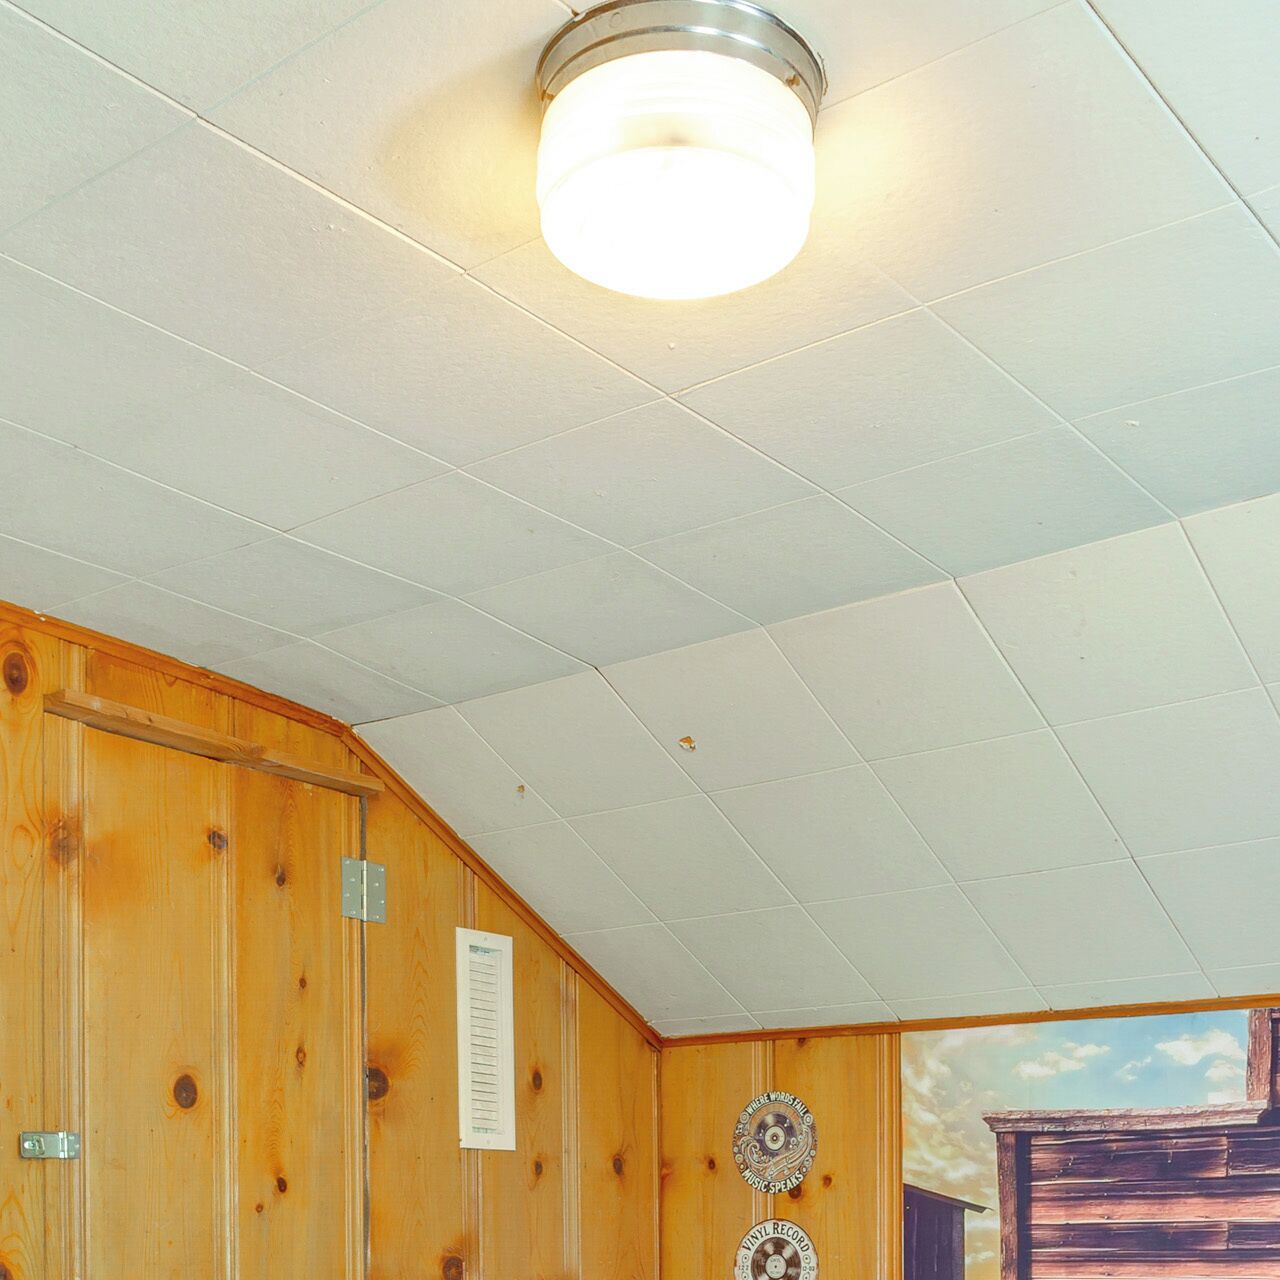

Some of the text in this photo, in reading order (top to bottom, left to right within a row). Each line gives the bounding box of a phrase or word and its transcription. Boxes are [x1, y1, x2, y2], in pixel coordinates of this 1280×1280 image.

[745, 1091, 808, 1117] WHERE WORDS FAIL
[741, 1168, 805, 1194] MUSIC SPEAKS
[741, 1221, 811, 1253] VINYL RECORD
